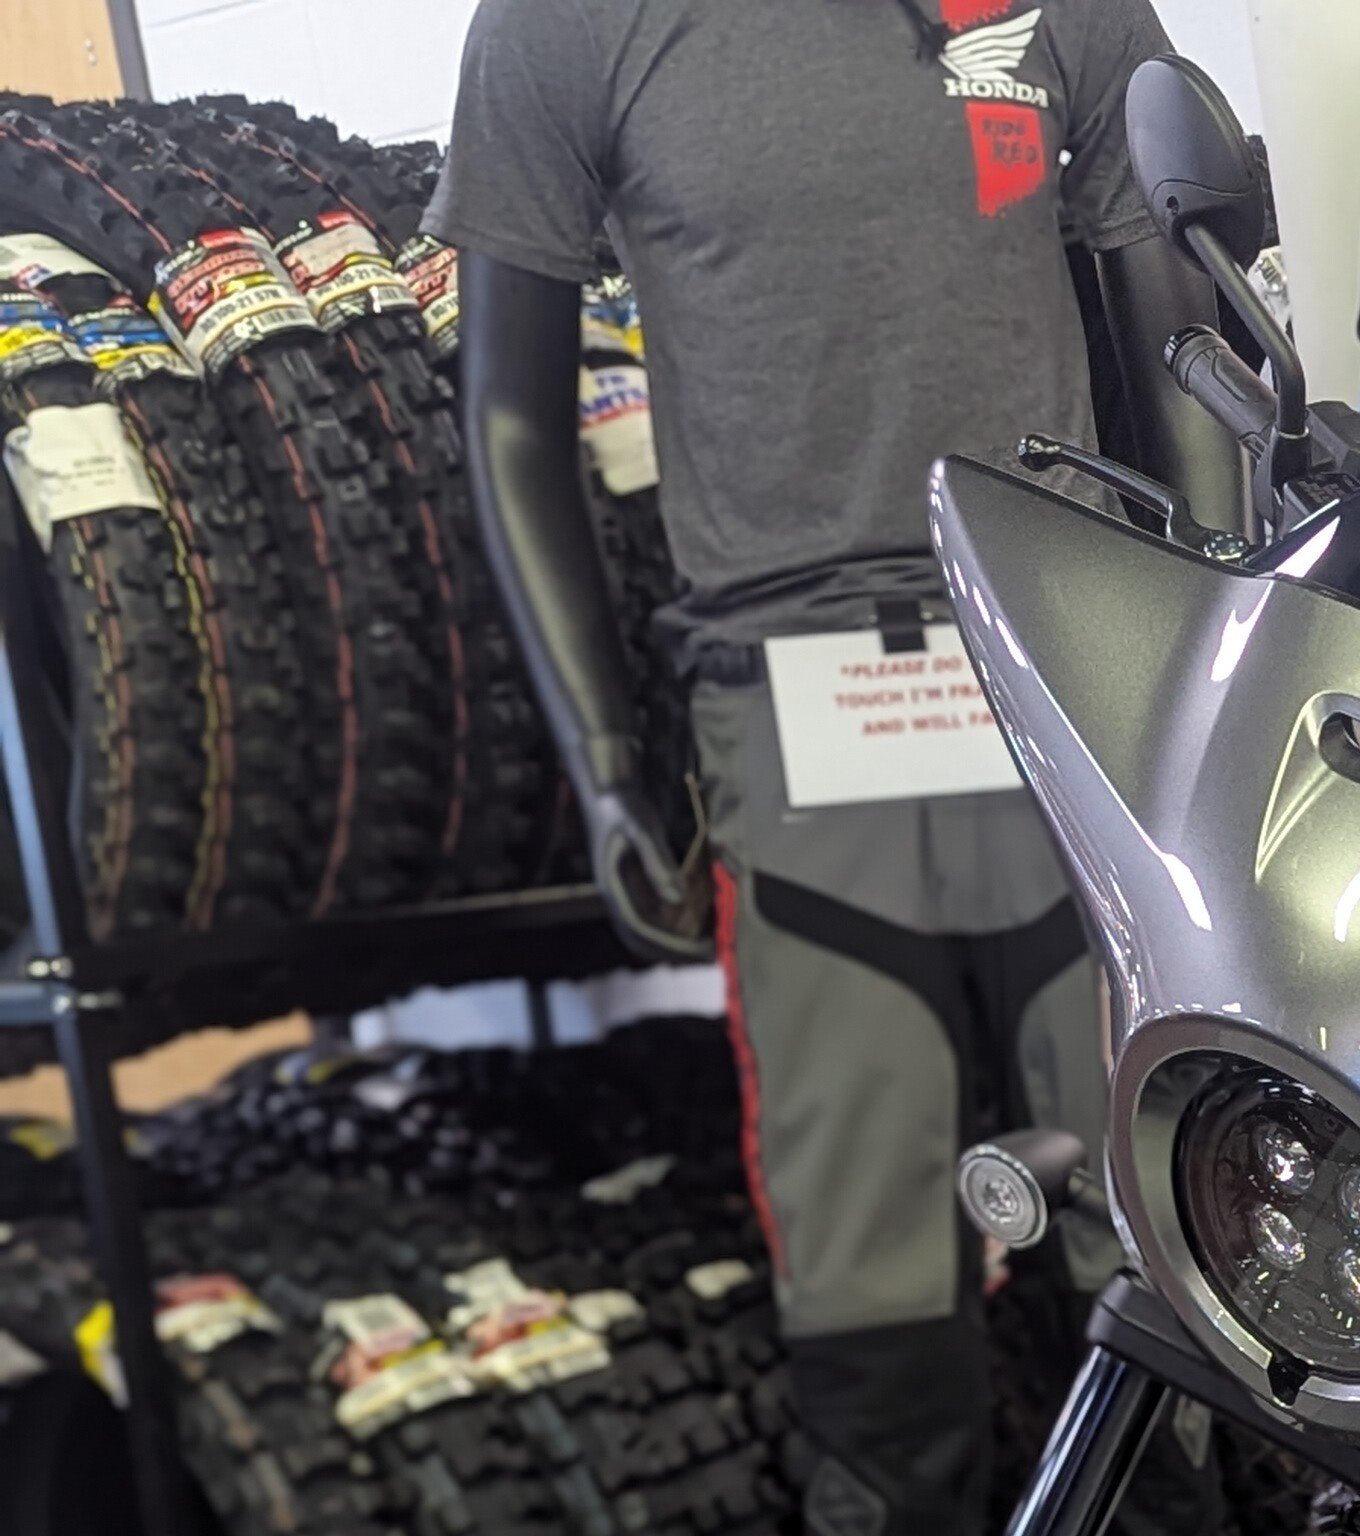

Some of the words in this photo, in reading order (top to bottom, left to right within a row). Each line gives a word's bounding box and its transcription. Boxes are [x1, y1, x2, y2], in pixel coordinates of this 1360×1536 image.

[943, 78, 1049, 108] HONDA
[991, 140, 1038, 165] RED
[932, 655, 963, 674] DO
[834, 690, 905, 709] TOUCH
[910, 686, 943, 704] I'M
[862, 717, 905, 736] AND
[911, 713, 963, 732] WILL
